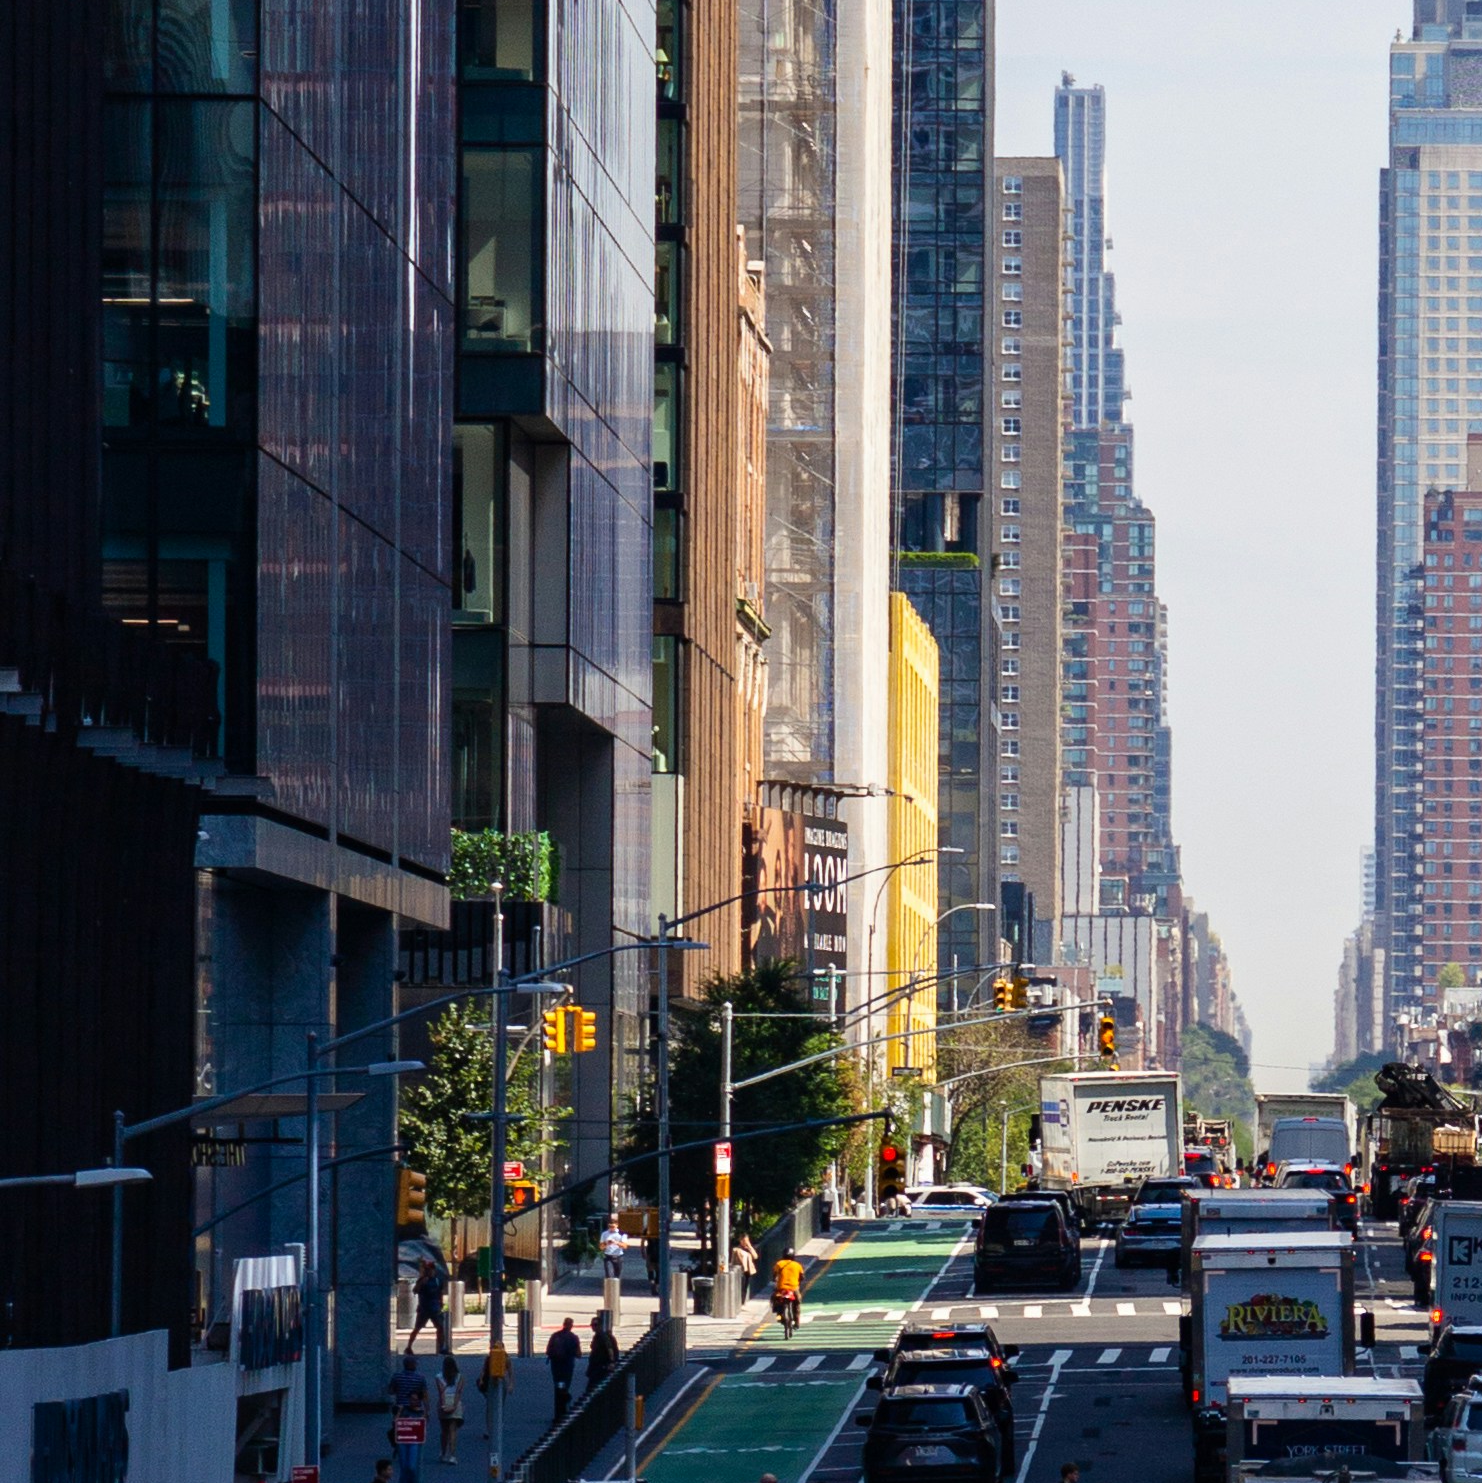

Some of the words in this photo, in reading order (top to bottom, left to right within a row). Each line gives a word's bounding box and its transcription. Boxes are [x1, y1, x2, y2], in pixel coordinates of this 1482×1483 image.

[804, 852, 847, 914] LOOM
[1086, 1099, 1166, 1114] PENSKE
[1226, 1302, 1326, 1333] RIVIERA
[1242, 1355, 1306, 1365] 201-227-7105
[1286, 1444, 1322, 1458] YORK
